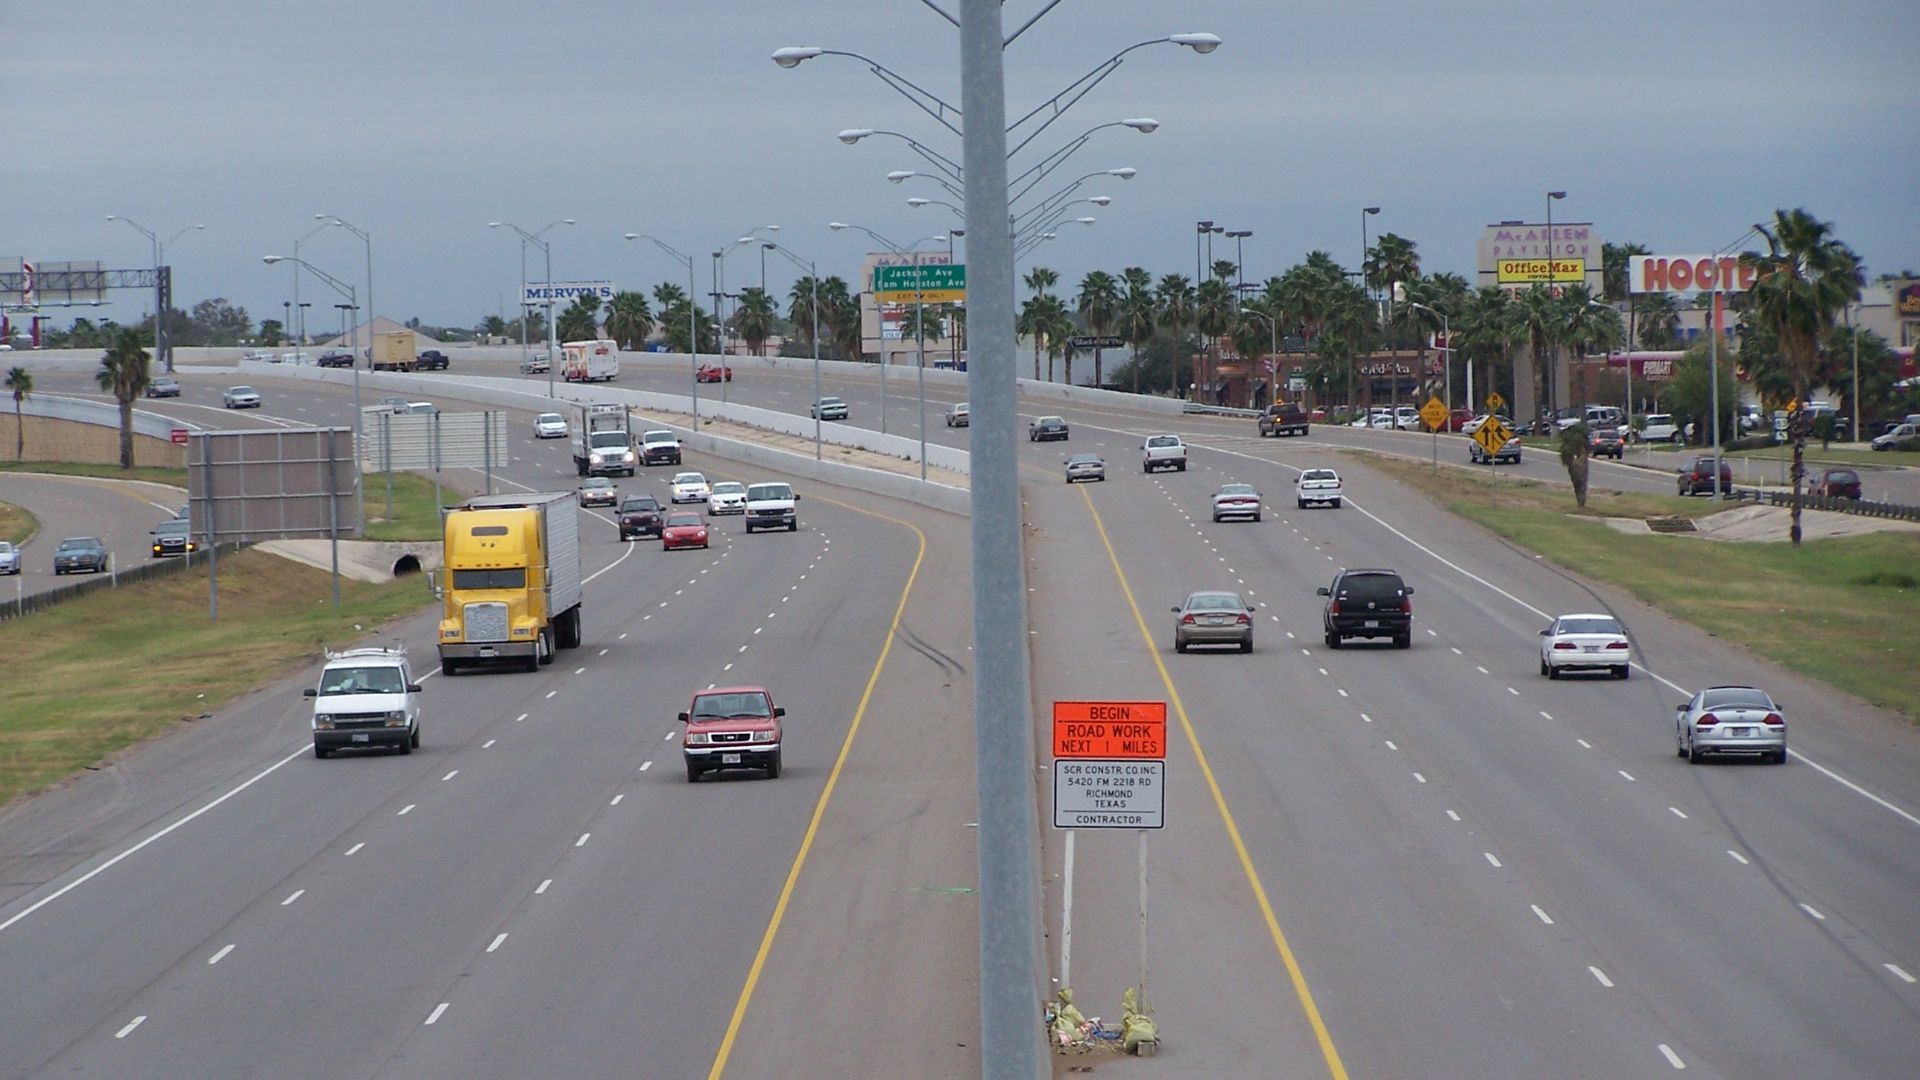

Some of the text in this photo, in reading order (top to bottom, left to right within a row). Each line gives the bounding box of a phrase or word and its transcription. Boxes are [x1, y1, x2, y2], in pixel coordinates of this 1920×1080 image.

[1493, 243, 1589, 256] PAVILION
[935, 268, 953, 277] Ave
[1504, 262, 1578, 274] OfficeMax
[1644, 257, 1756, 291] HOOTE
[903, 279, 941, 288] Hoston
[948, 278, 965, 287] Ave
[1090, 706, 1130, 720] BEGIN
[1067, 725, 1151, 738] ROAD WORK
[1061, 740, 1157, 753] NEXT 1 MILES
[1064, 765, 1082, 774] SCR
[1068, 778, 1152, 786] 5420 FM 2218 RD
[1086, 789, 1133, 798] RICHMOND
[1095, 800, 1127, 808] TEXAS
[1076, 815, 1142, 824] CONTRACTOR
